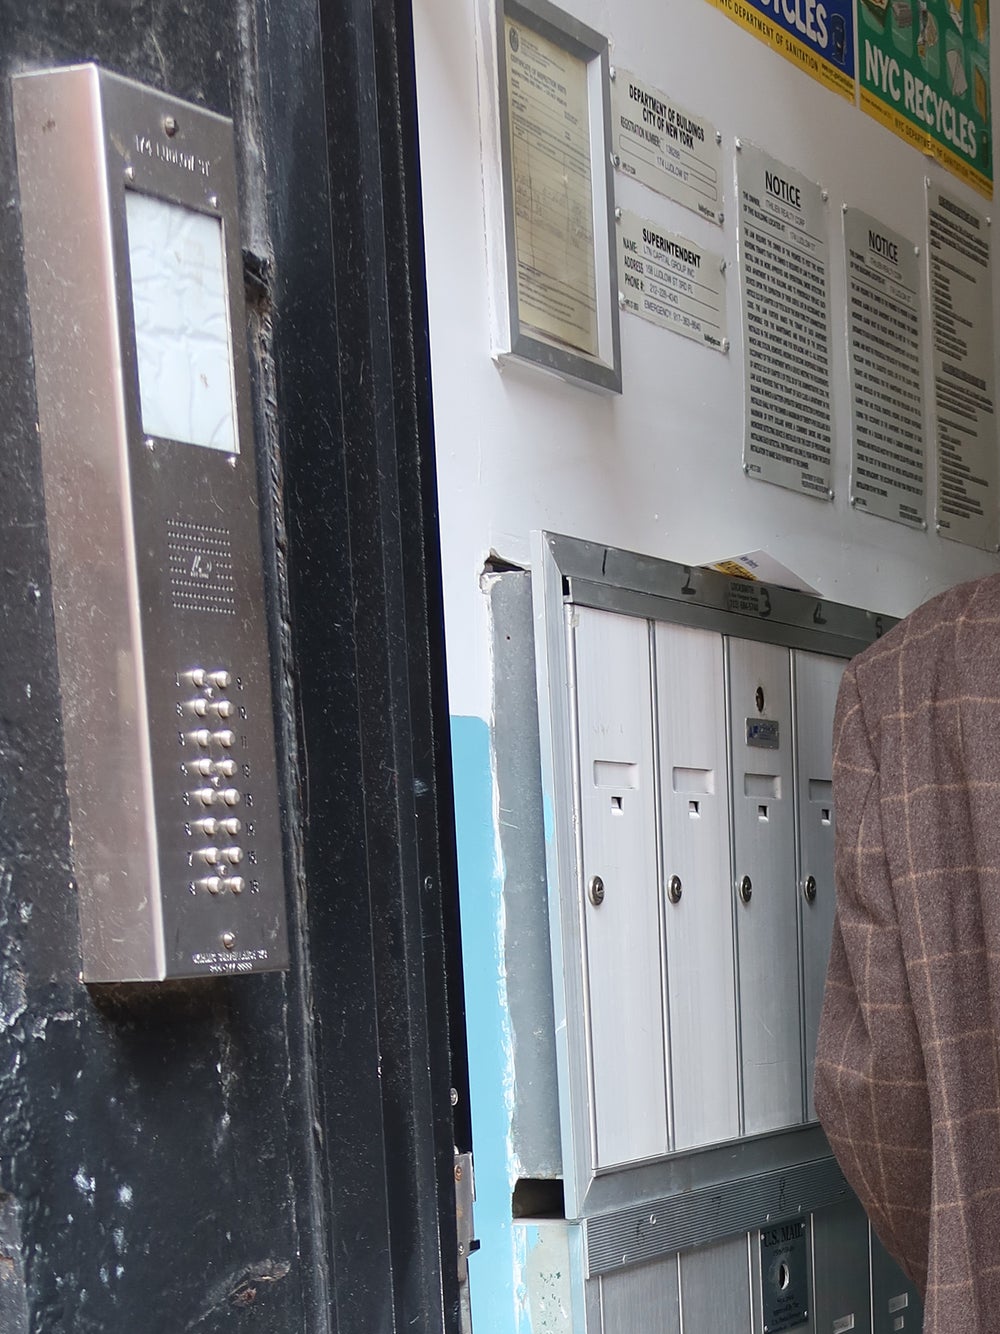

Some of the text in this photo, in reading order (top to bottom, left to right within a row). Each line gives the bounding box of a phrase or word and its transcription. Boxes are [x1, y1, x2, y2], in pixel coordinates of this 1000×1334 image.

[734, 3, 774, 39] DEPARTMENT
[775, 32, 783, 46] OF
[785, 39, 819, 72] SANITATION
[761, 0, 828, 48] CLES
[629, 84, 704, 142] DEPARTMENT OF BUILDINGS
[865, 39, 900, 101] NYC
[903, 68, 977, 159] RECYCLES
[621, 116, 645, 139] REGISTRATION
[643, 108, 694, 150] CITY OF NEW YORK
[895, 118, 904, 133] NYC
[664, 160, 683, 179] LUDLOW
[684, 171, 689, 181] ST
[765, 170, 801, 208] NOTICE
[642, 228, 701, 268] SUPERINTENDENT
[653, 248, 670, 267] CAPITAL
[670, 260, 686, 274] GROUP
[869, 230, 898, 262] NOTICE
[624, 273, 639, 290] PHONE
[654, 267, 672, 283] LUDLOW
[672, 277, 678, 286] ST
[681, 566, 696, 594] 2
[759, 587, 772, 617] 3
[781, 1223, 804, 1242] MAIL
